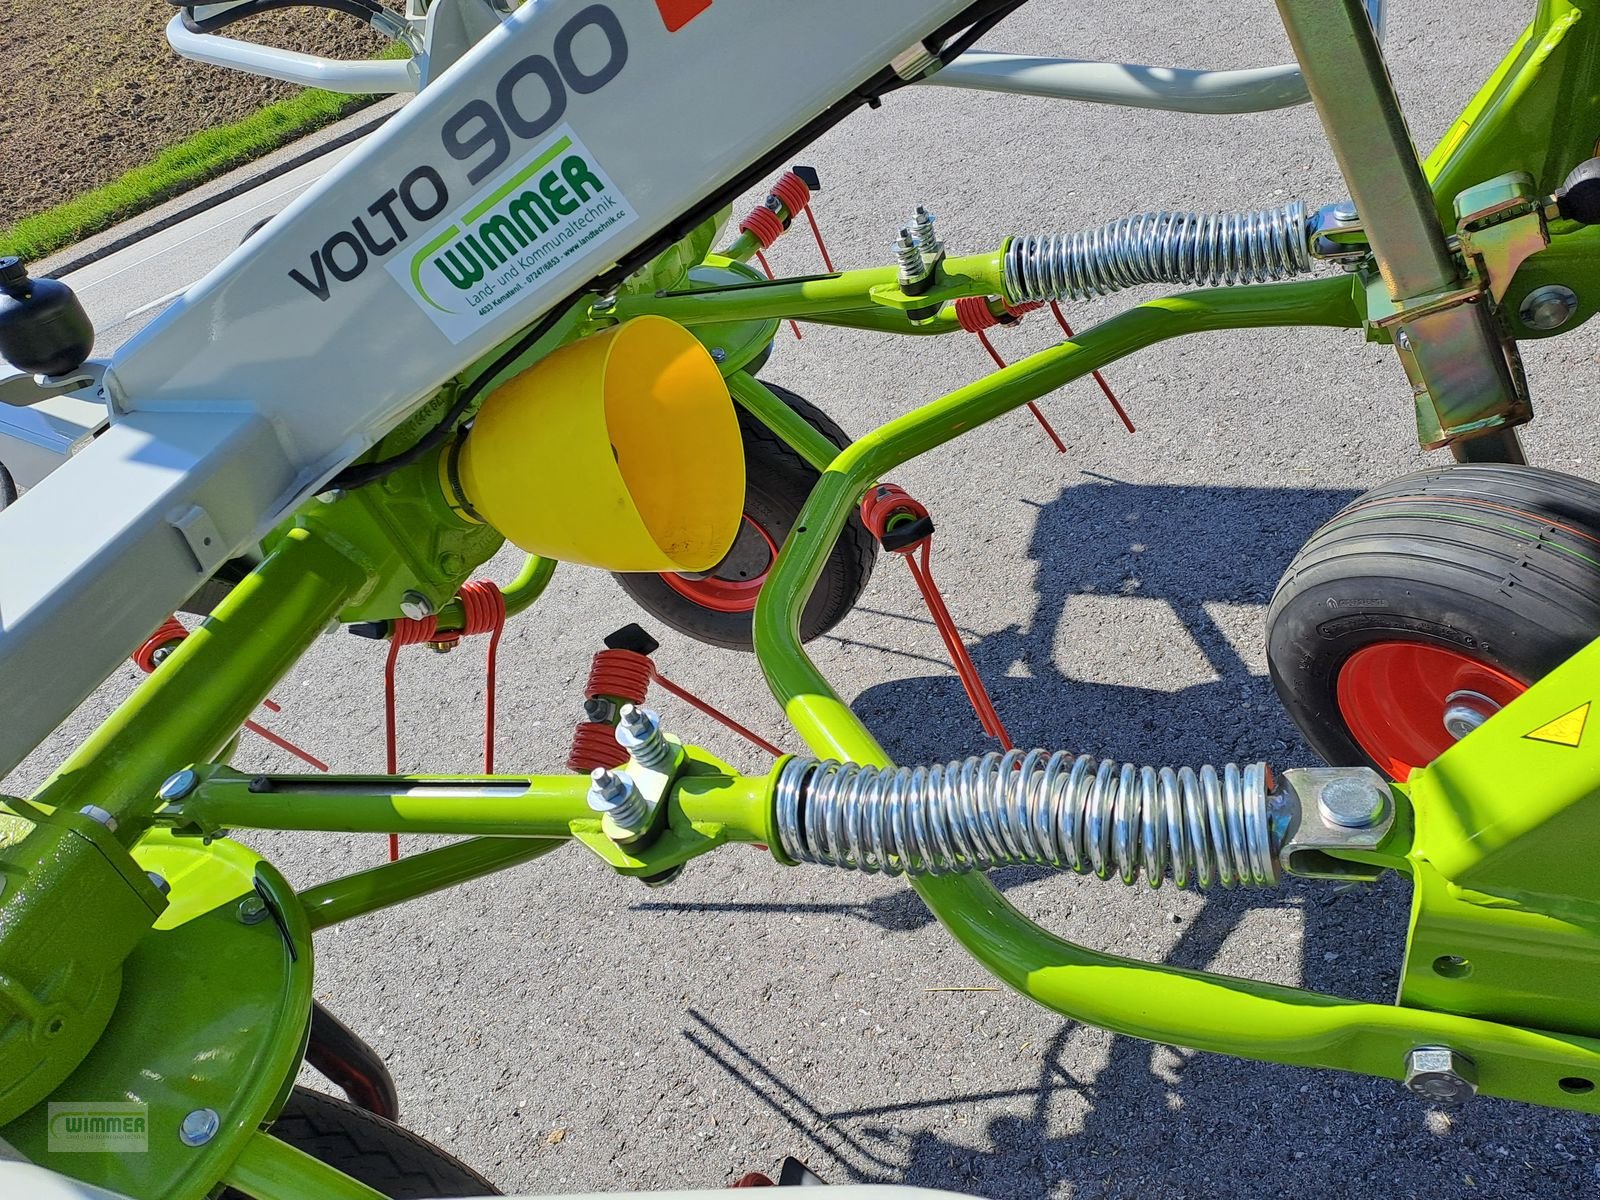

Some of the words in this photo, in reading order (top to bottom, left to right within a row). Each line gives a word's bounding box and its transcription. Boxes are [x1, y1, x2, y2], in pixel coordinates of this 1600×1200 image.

[288, 165, 449, 302] VOLTO
[441, 3, 629, 186] 900
[433, 155, 605, 290] WIMMER
[465, 284, 496, 307] Land-
[497, 265, 519, 287] und
[518, 195, 616, 271] Kommunaltechnik
[479, 303, 494, 316] 4633
[526, 256, 561, 283] 07247/6853
[563, 210, 626, 257] www.landtechnik.cc
